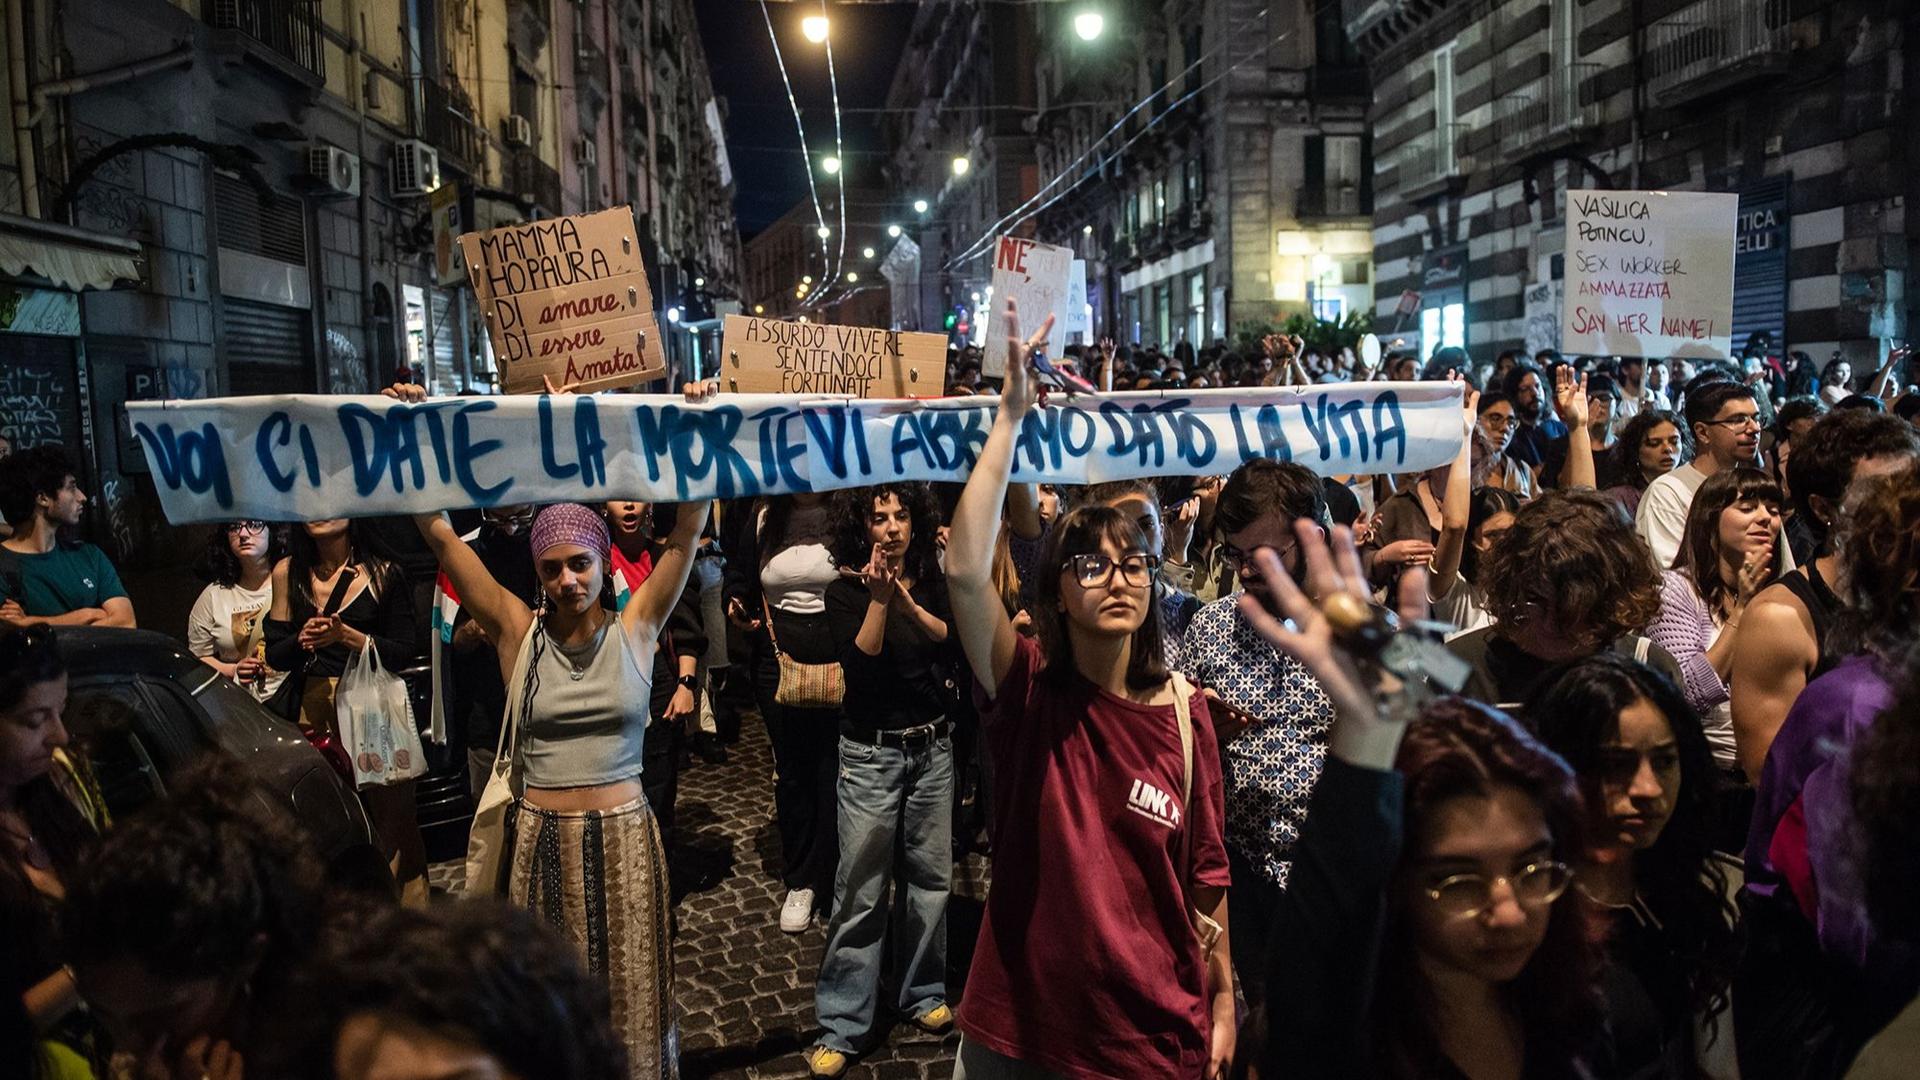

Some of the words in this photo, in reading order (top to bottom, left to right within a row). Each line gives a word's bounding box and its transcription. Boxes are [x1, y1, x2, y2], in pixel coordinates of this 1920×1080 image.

[1574, 194, 1650, 221] VASILICA
[1739, 209, 1776, 231] TICA
[479, 218, 581, 266] MAMMA
[1575, 250, 1609, 273] SEX
[1620, 257, 1687, 276] WORKER
[1578, 281, 1671, 299] AMMAZZATA
[495, 296, 524, 331] DI
[538, 292, 625, 325] amare,
[1572, 306, 1606, 335] SAY
[1617, 312, 1652, 335] HER
[504, 330, 533, 362] DI
[539, 327, 606, 357] essere
[746, 318, 826, 349] ASSURDO
[836, 327, 905, 357] VIVERE
[564, 346, 647, 386] Amata!
[775, 345, 883, 380] SENTENDOCI
[135, 374, 151, 393] P
[782, 369, 873, 398] FORTUNATE
[135, 421, 234, 509] VOI
[256, 411, 321, 493] CI
[337, 400, 515, 506] DATE
[538, 394, 608, 488] LA
[891, 405, 1097, 475] ABBAMO
[1098, 398, 1218, 468] DATO
[1230, 403, 1293, 464] LA
[1301, 390, 1406, 466] VITA
[1128, 778, 1171, 818] LINK
